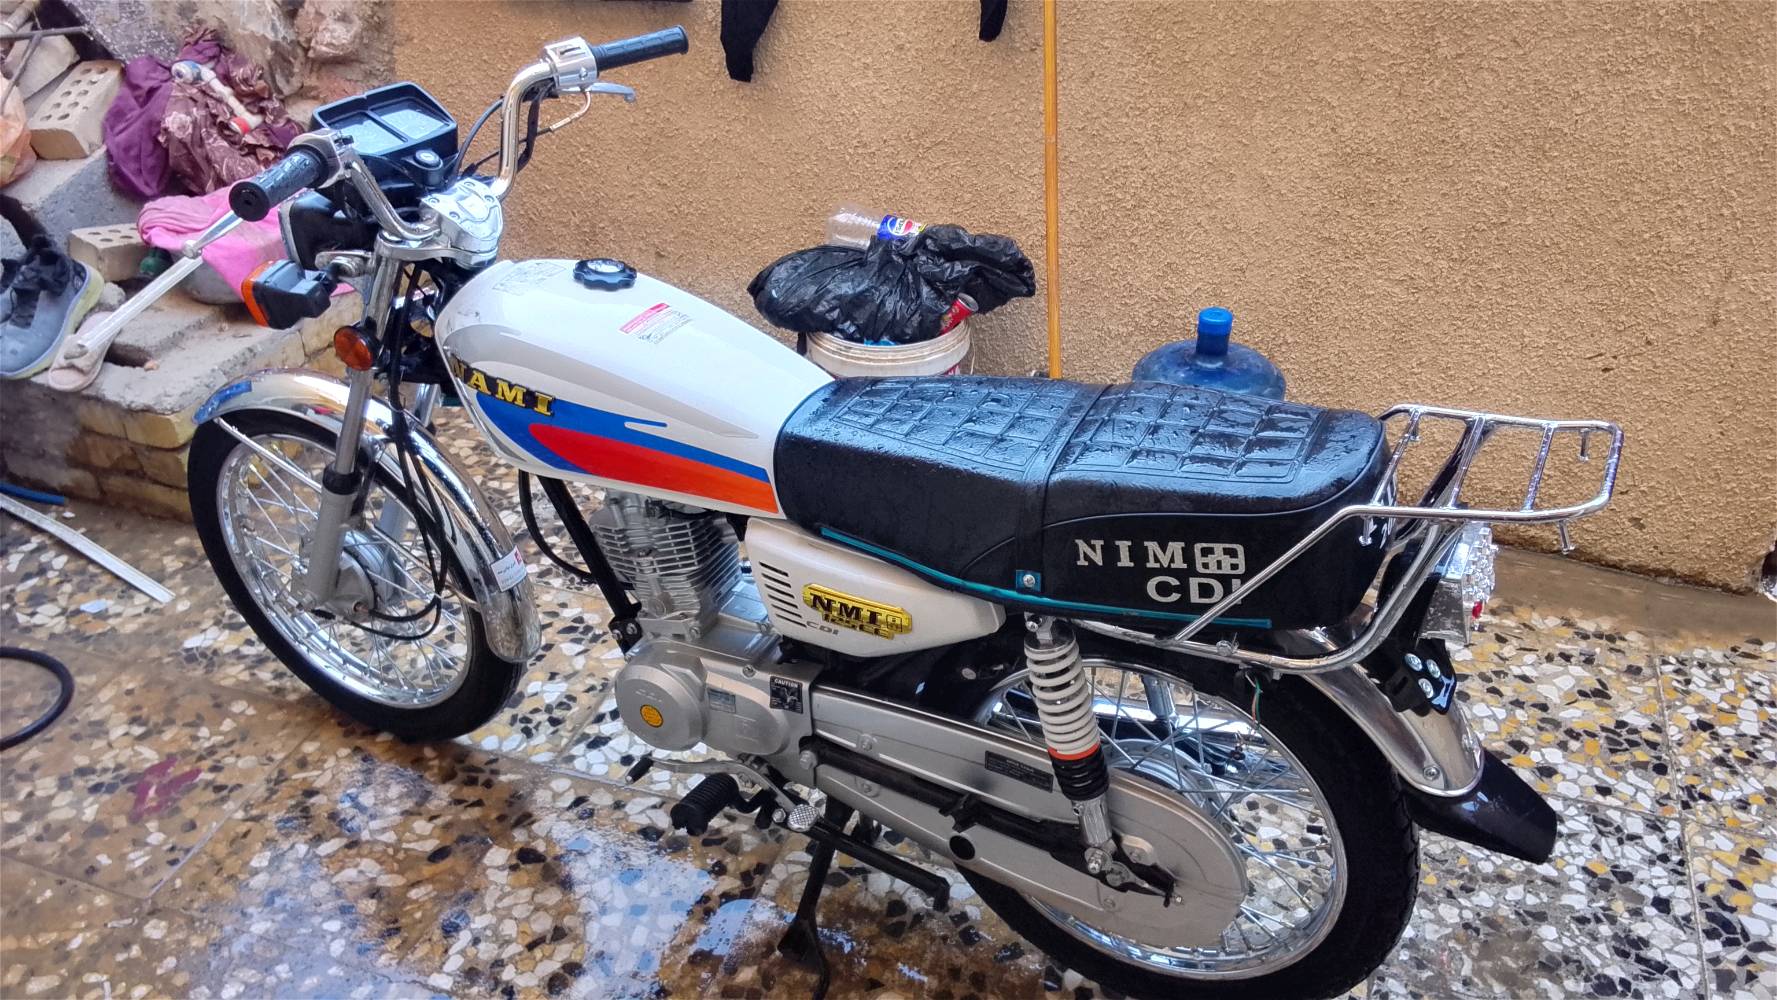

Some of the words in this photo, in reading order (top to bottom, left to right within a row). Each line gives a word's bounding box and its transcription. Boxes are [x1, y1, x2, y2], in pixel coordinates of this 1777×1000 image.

[449, 355, 553, 416] NAMI
[1074, 538, 1188, 569] NIM
[806, 620, 839, 635] CDI
[774, 678, 798, 688] CAUTION
